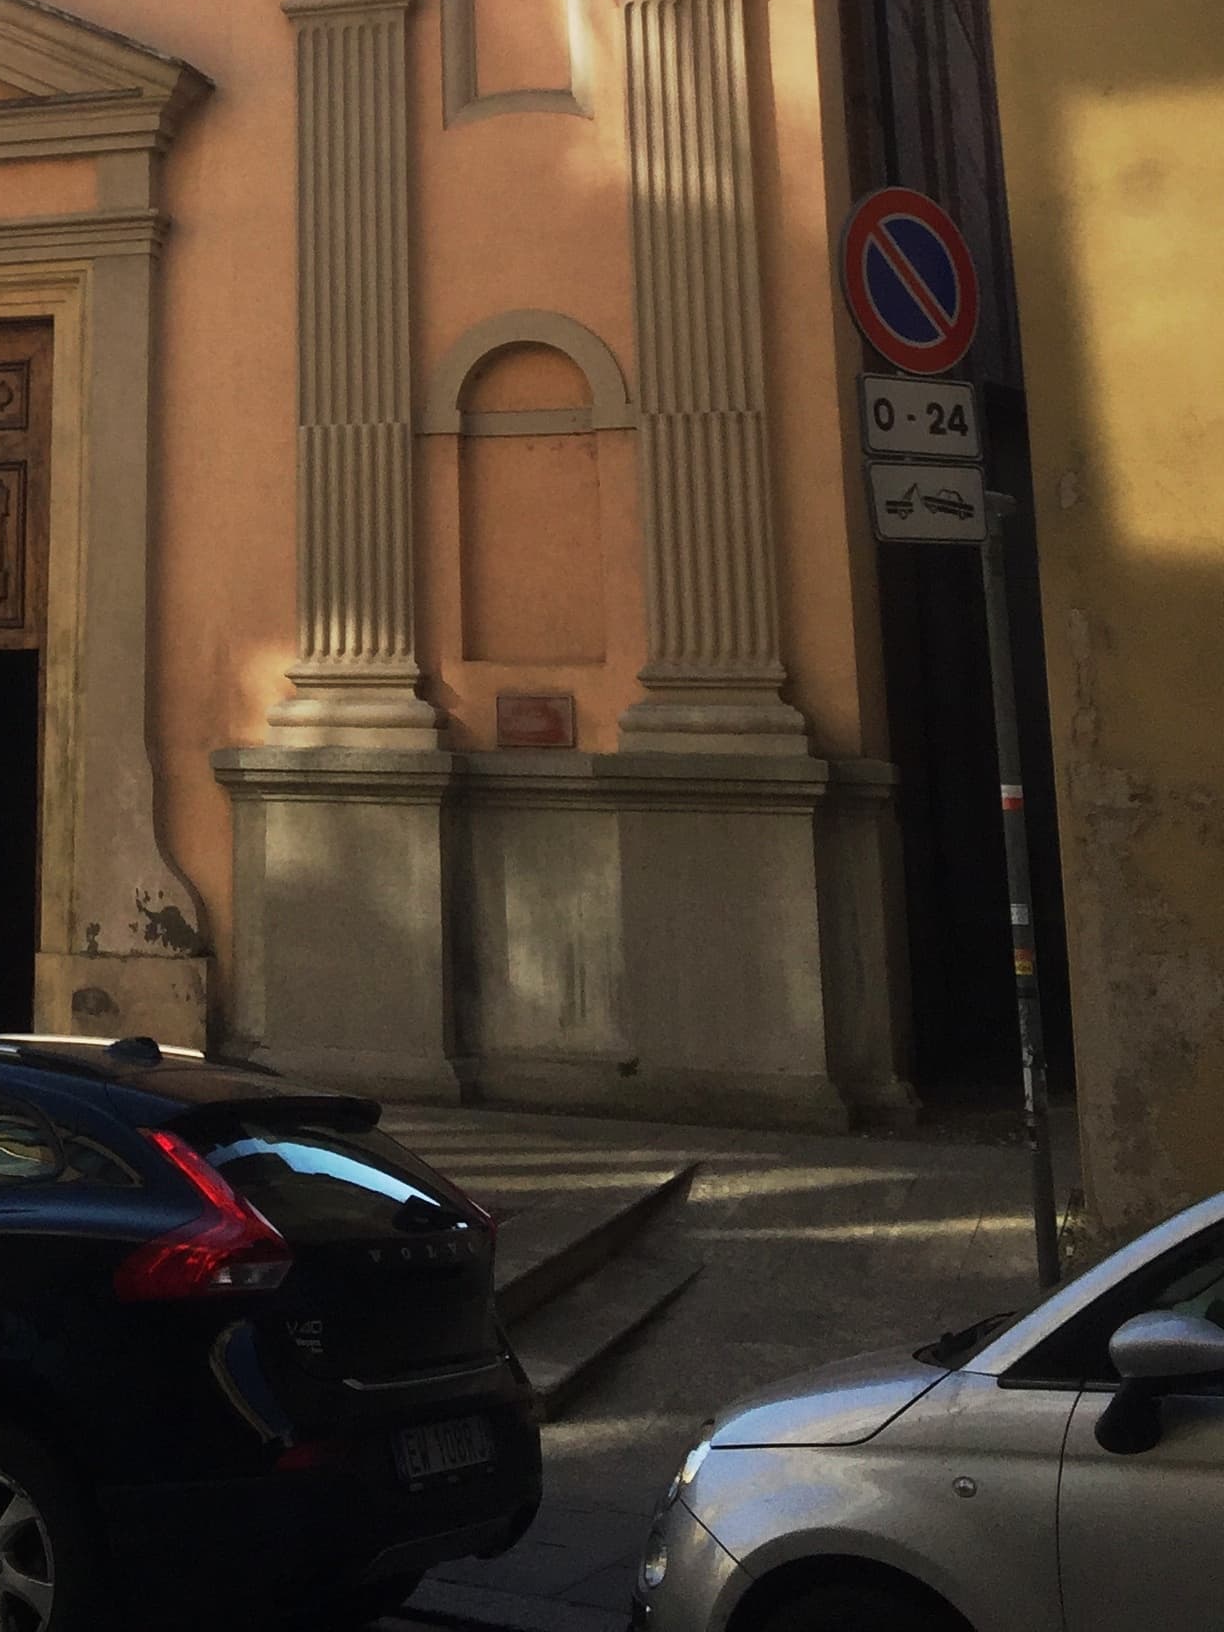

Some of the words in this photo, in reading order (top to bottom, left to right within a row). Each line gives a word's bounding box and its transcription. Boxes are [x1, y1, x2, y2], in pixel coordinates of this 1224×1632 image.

[874, 397, 895, 431] 0
[926, 402, 968, 436] 24
[285, 1319, 323, 1336] V40
